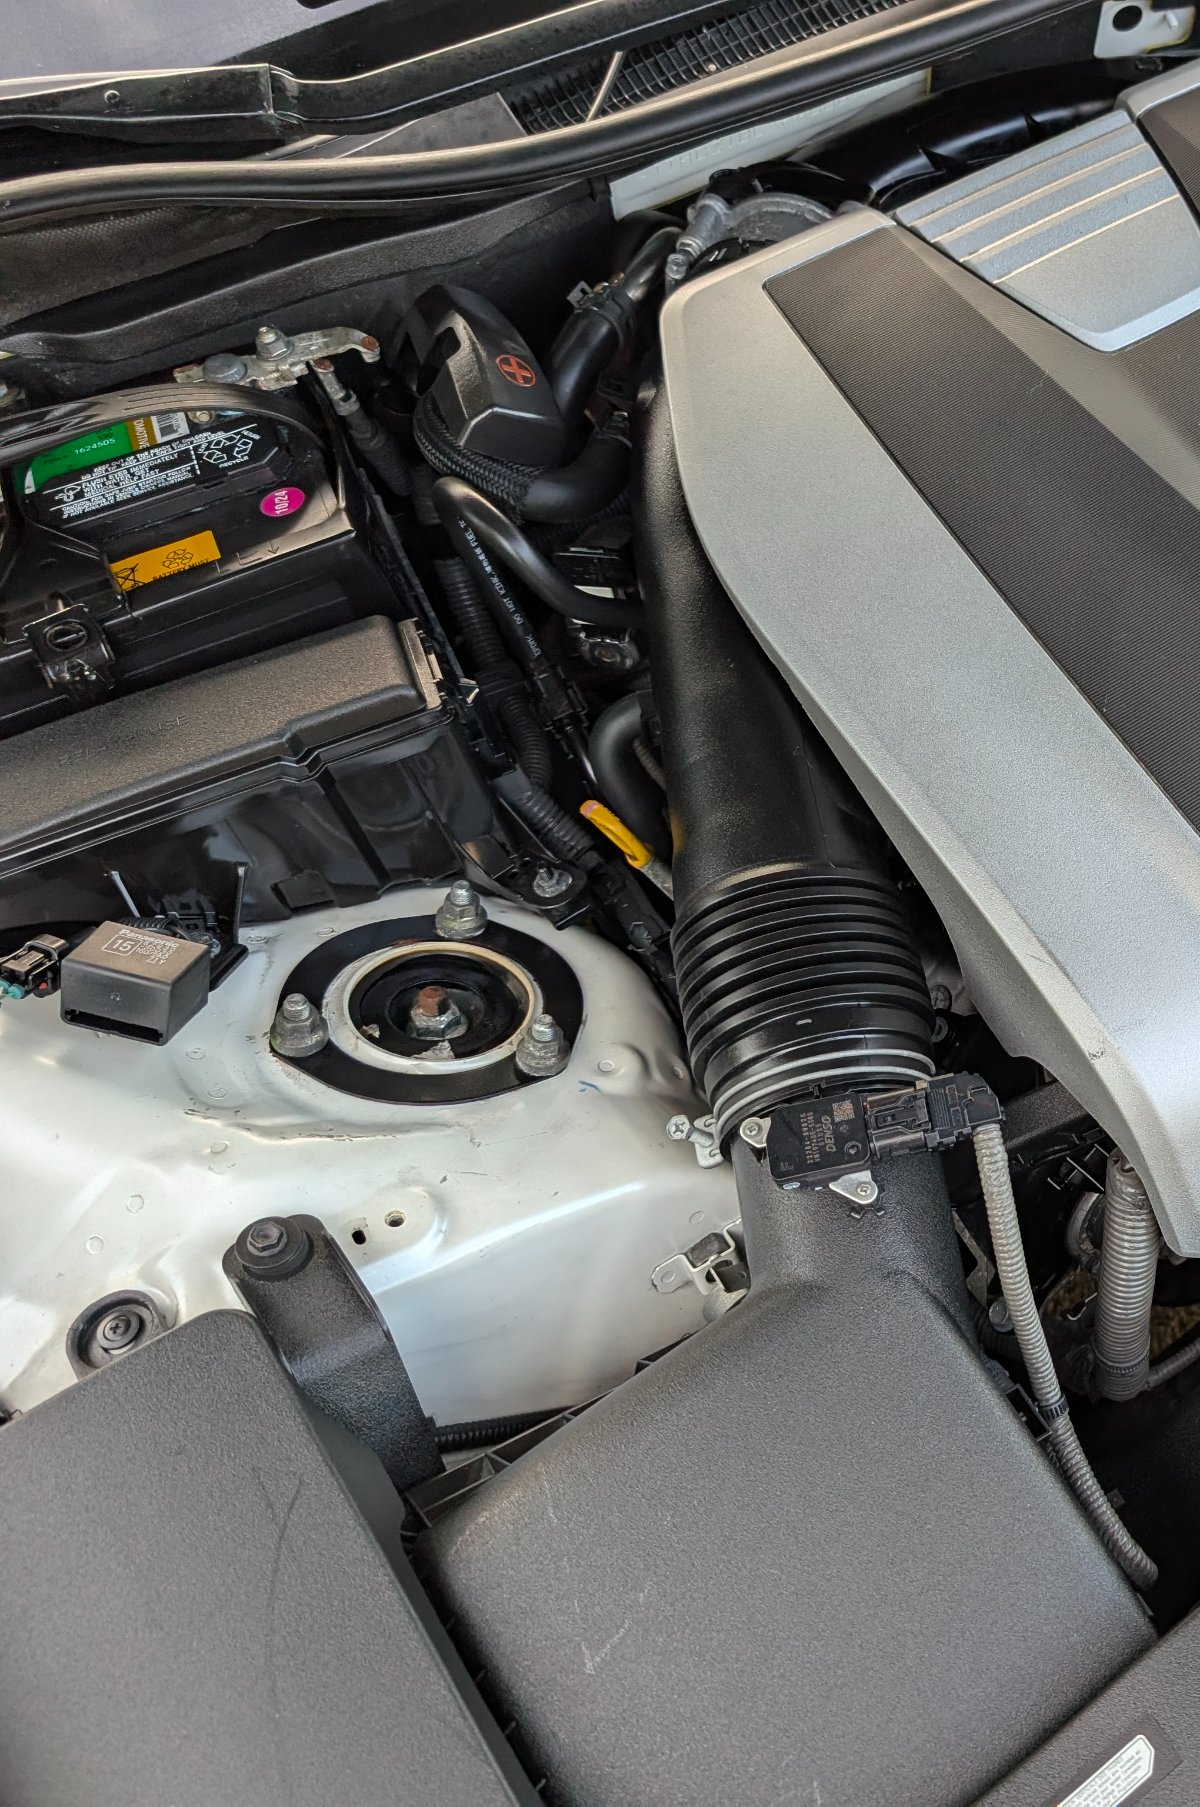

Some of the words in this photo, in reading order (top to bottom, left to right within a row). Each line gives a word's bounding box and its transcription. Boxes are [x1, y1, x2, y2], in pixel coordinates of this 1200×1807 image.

[74, 439, 116, 455] 1624505
[111, 458, 124, 466] OUT
[135, 450, 149, 458] THE
[219, 456, 249, 468] RECYCLE
[81, 475, 107, 488] FLUSH
[108, 468, 128, 479] EYES
[129, 452, 179, 472] IMMEDIATELY
[82, 482, 103, 492] WITH
[134, 467, 149, 476] GET
[83, 482, 117, 497] MEDICAL
[119, 475, 138, 485] HELP
[140, 468, 160, 479] FAST
[275, 490, 289, 514] 10/24
[514, 613, 524, 625] DO
[114, 939, 134, 952] 15
[118, 929, 180, 948] Panasonic
[822, 1115, 837, 1152] DENSO
